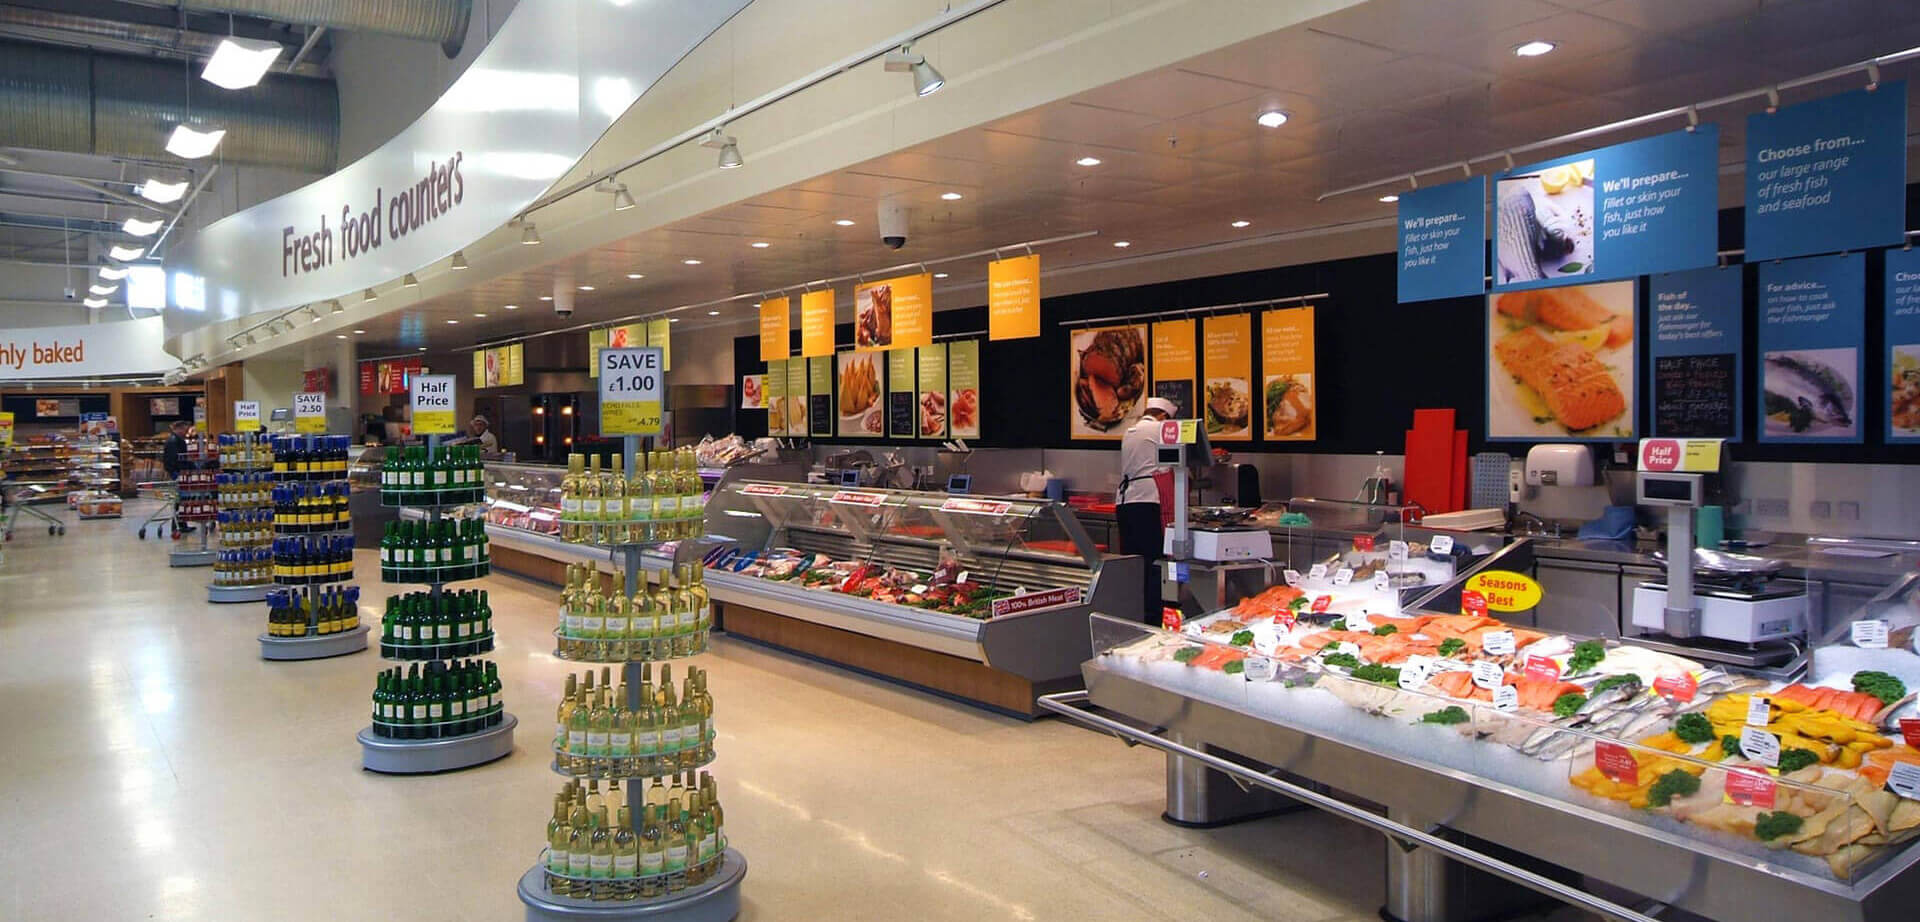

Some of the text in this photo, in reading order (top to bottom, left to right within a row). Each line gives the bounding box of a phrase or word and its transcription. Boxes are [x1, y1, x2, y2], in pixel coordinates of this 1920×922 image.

[1758, 136, 1865, 162] Choose from...
[1758, 157, 1849, 181] our large range
[1603, 170, 1689, 193] We'll prepare...
[1758, 176, 1828, 198] of fresh fish
[1603, 188, 1681, 212] fillet or skin your
[1758, 192, 1832, 214] and seafood
[283, 151, 464, 277] Fresh food counters
[1404, 213, 1466, 229] We'll prepare...
[1603, 205, 1665, 226] fish, just how
[1444, 228, 1460, 238] your
[1603, 221, 1648, 240] you like it
[1434, 242, 1450, 251] how
[1404, 260, 1417, 270] you
[1418, 256, 1430, 266] like
[1767, 283, 1783, 292] For
[33, 339, 84, 364] baked
[607, 354, 656, 369] SAVE
[421, 382, 448, 392] Half
[609, 375, 654, 391] £1.00
[297, 395, 321, 403] SAVE
[418, 396, 449, 405] Price
[1651, 446, 1672, 455] Half
[1648, 455, 1673, 464] Price
[1480, 575, 1527, 592] Seasons
[1487, 592, 1514, 607] Best
